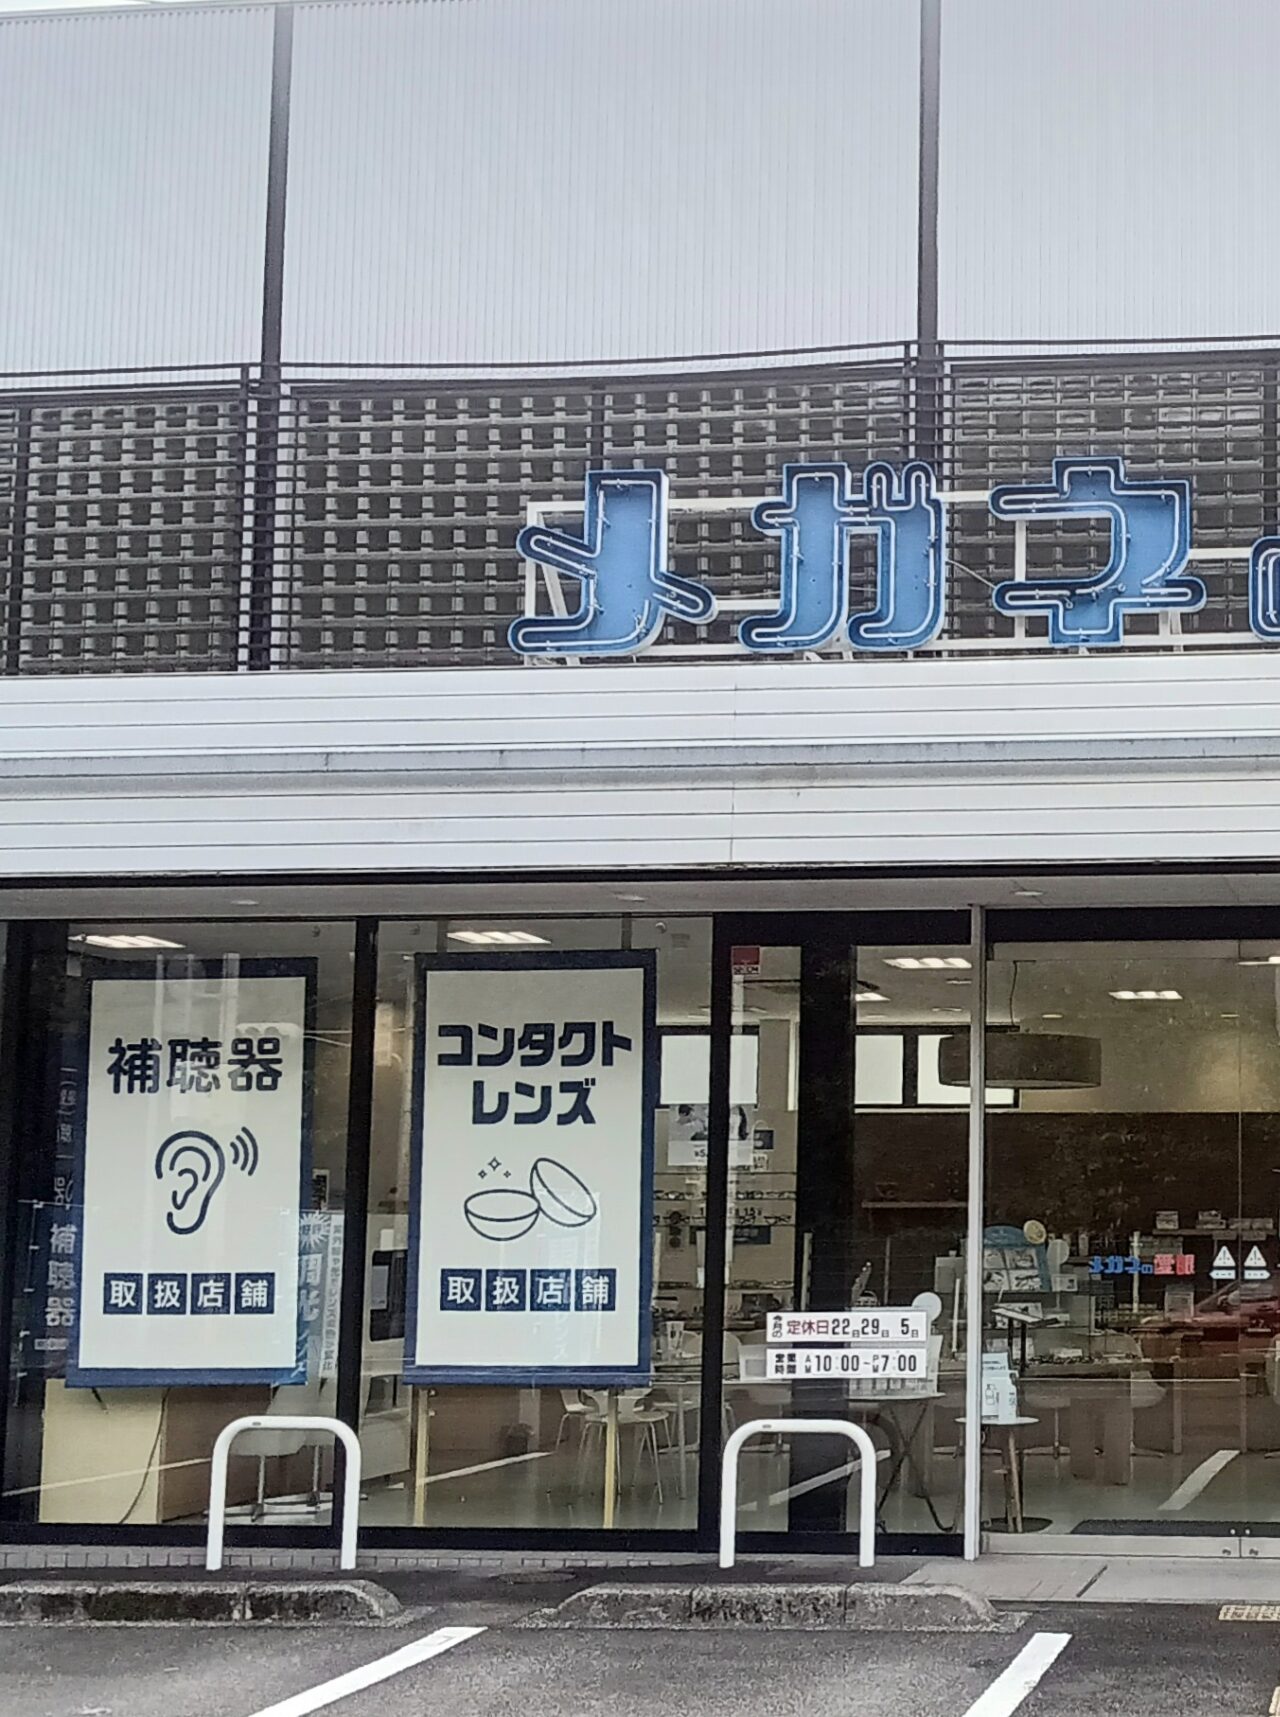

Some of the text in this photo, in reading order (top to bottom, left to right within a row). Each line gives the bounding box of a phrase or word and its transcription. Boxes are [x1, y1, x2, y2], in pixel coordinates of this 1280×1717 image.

[107, 1037, 283, 1094] 補聴器
[438, 1021, 632, 1067] コンタクト
[472, 1078, 596, 1125] レンズ
[107, 1278, 270, 1309] 取扱店舗
[446, 1275, 610, 1306] 取扱店舗
